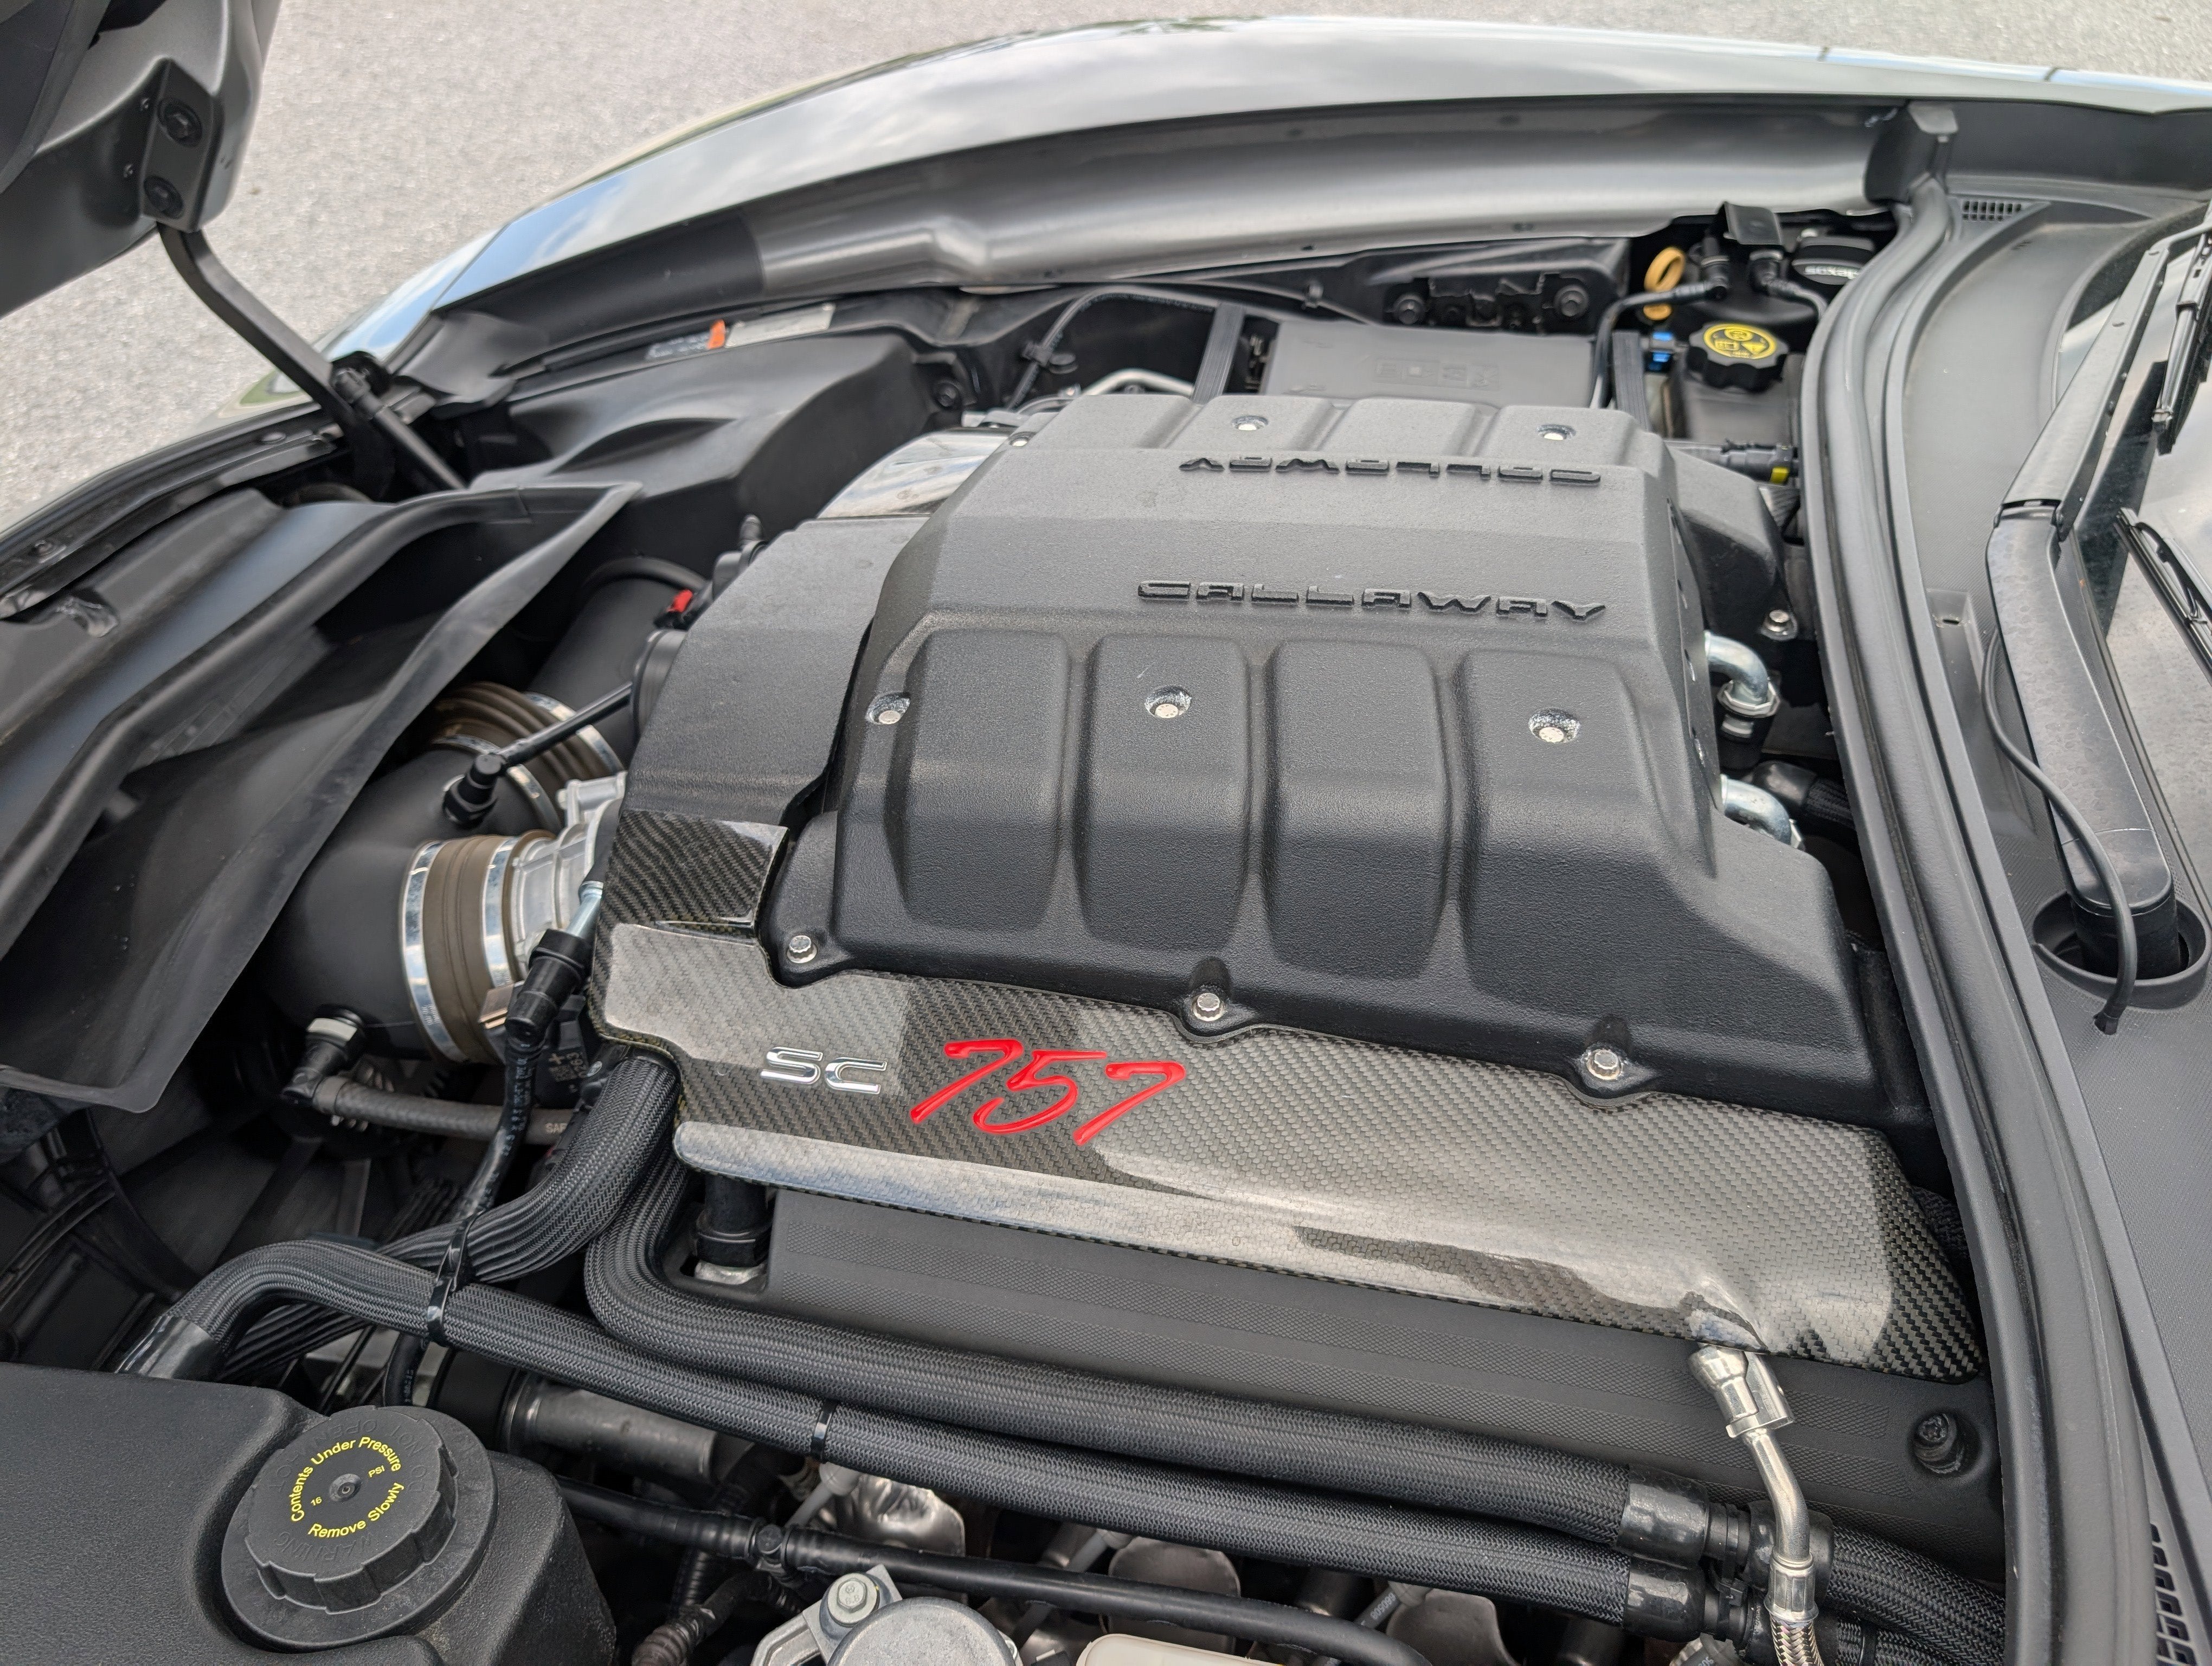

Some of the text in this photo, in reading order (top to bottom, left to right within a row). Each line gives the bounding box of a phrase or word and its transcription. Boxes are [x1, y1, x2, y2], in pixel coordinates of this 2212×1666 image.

[1179, 457, 1601, 485] CALLAWAY
[1137, 579, 1606, 620] CALLAWAY
[760, 1038, 1186, 1146] SC 757
[289, 1436, 402, 1523] Contents Under Pressure
[311, 1465, 385, 1507] 16 PSI
[307, 1482, 404, 1539] Remove Slowly
